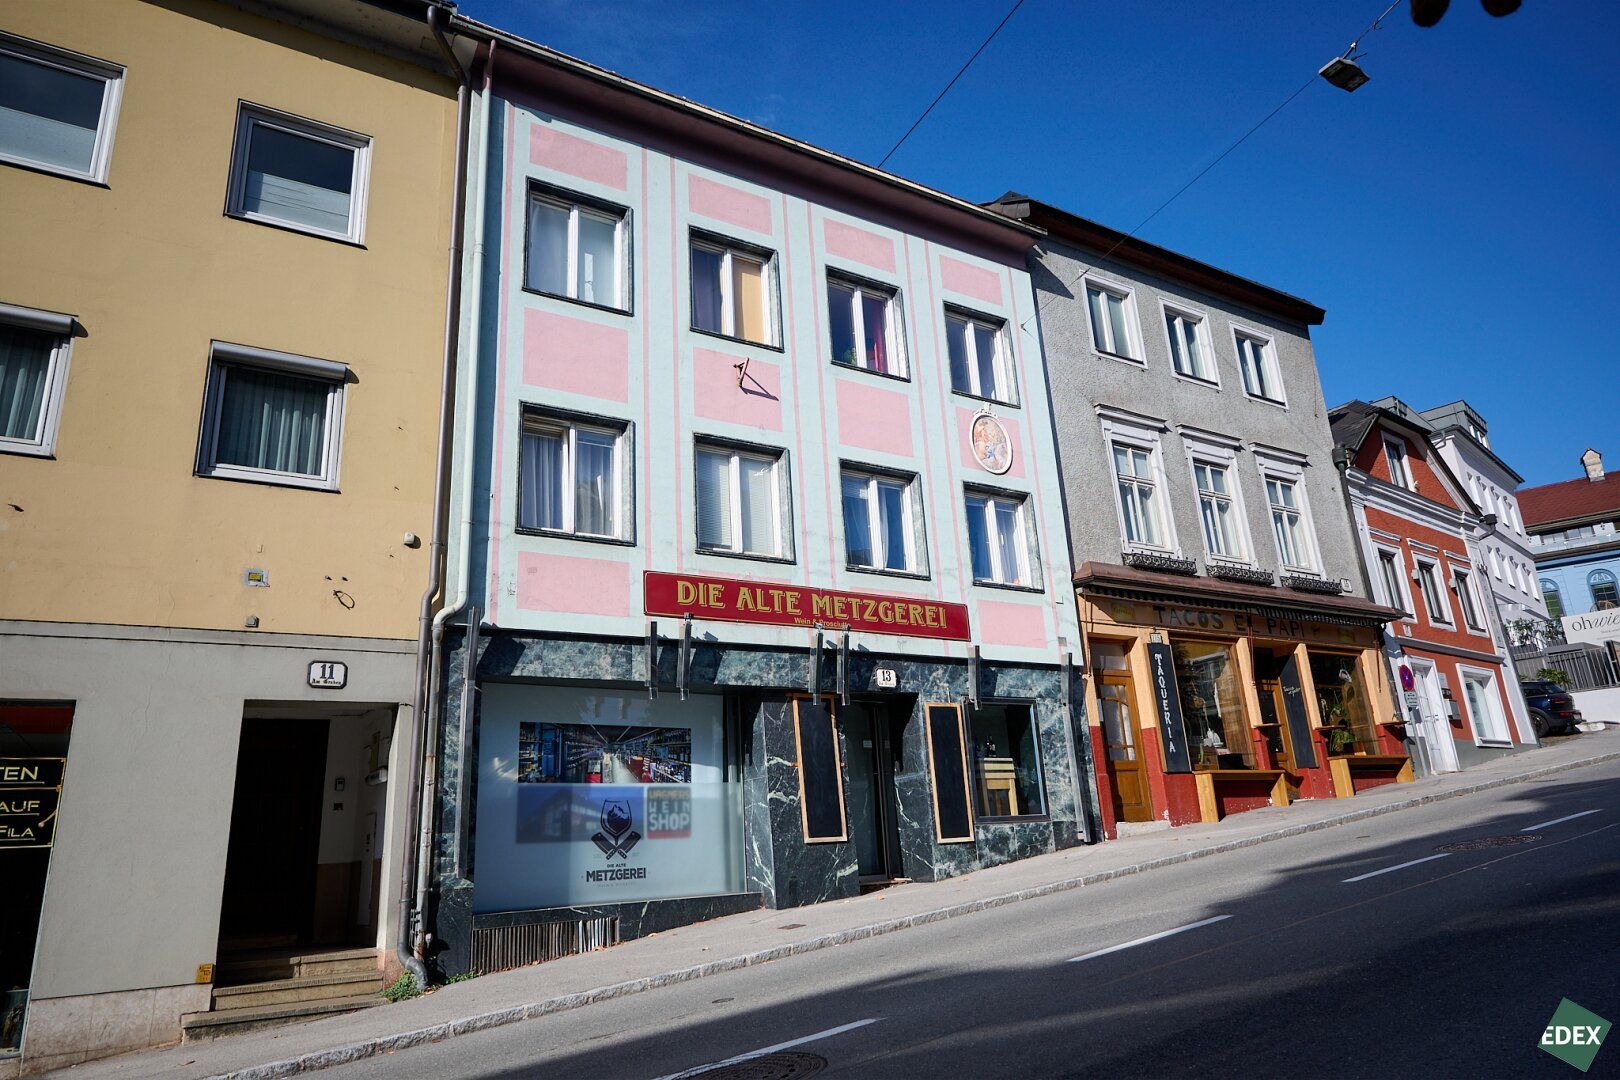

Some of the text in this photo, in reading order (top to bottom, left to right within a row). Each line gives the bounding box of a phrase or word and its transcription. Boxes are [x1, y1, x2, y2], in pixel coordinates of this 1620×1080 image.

[676, 580, 948, 629] DIE ALTE METZGEREI
[794, 617, 811, 625] Wein
[1154, 606, 1224, 630] TACOS
[1266, 617, 1306, 639] PAPI
[319, 663, 335, 680] 11
[881, 670, 892, 682] 13
[1154, 652, 1176, 753] TAQUERIA
[649, 800, 690, 813] WEIN
[649, 813, 690, 830] SHOP
[586, 867, 646, 882] METZGEREI
